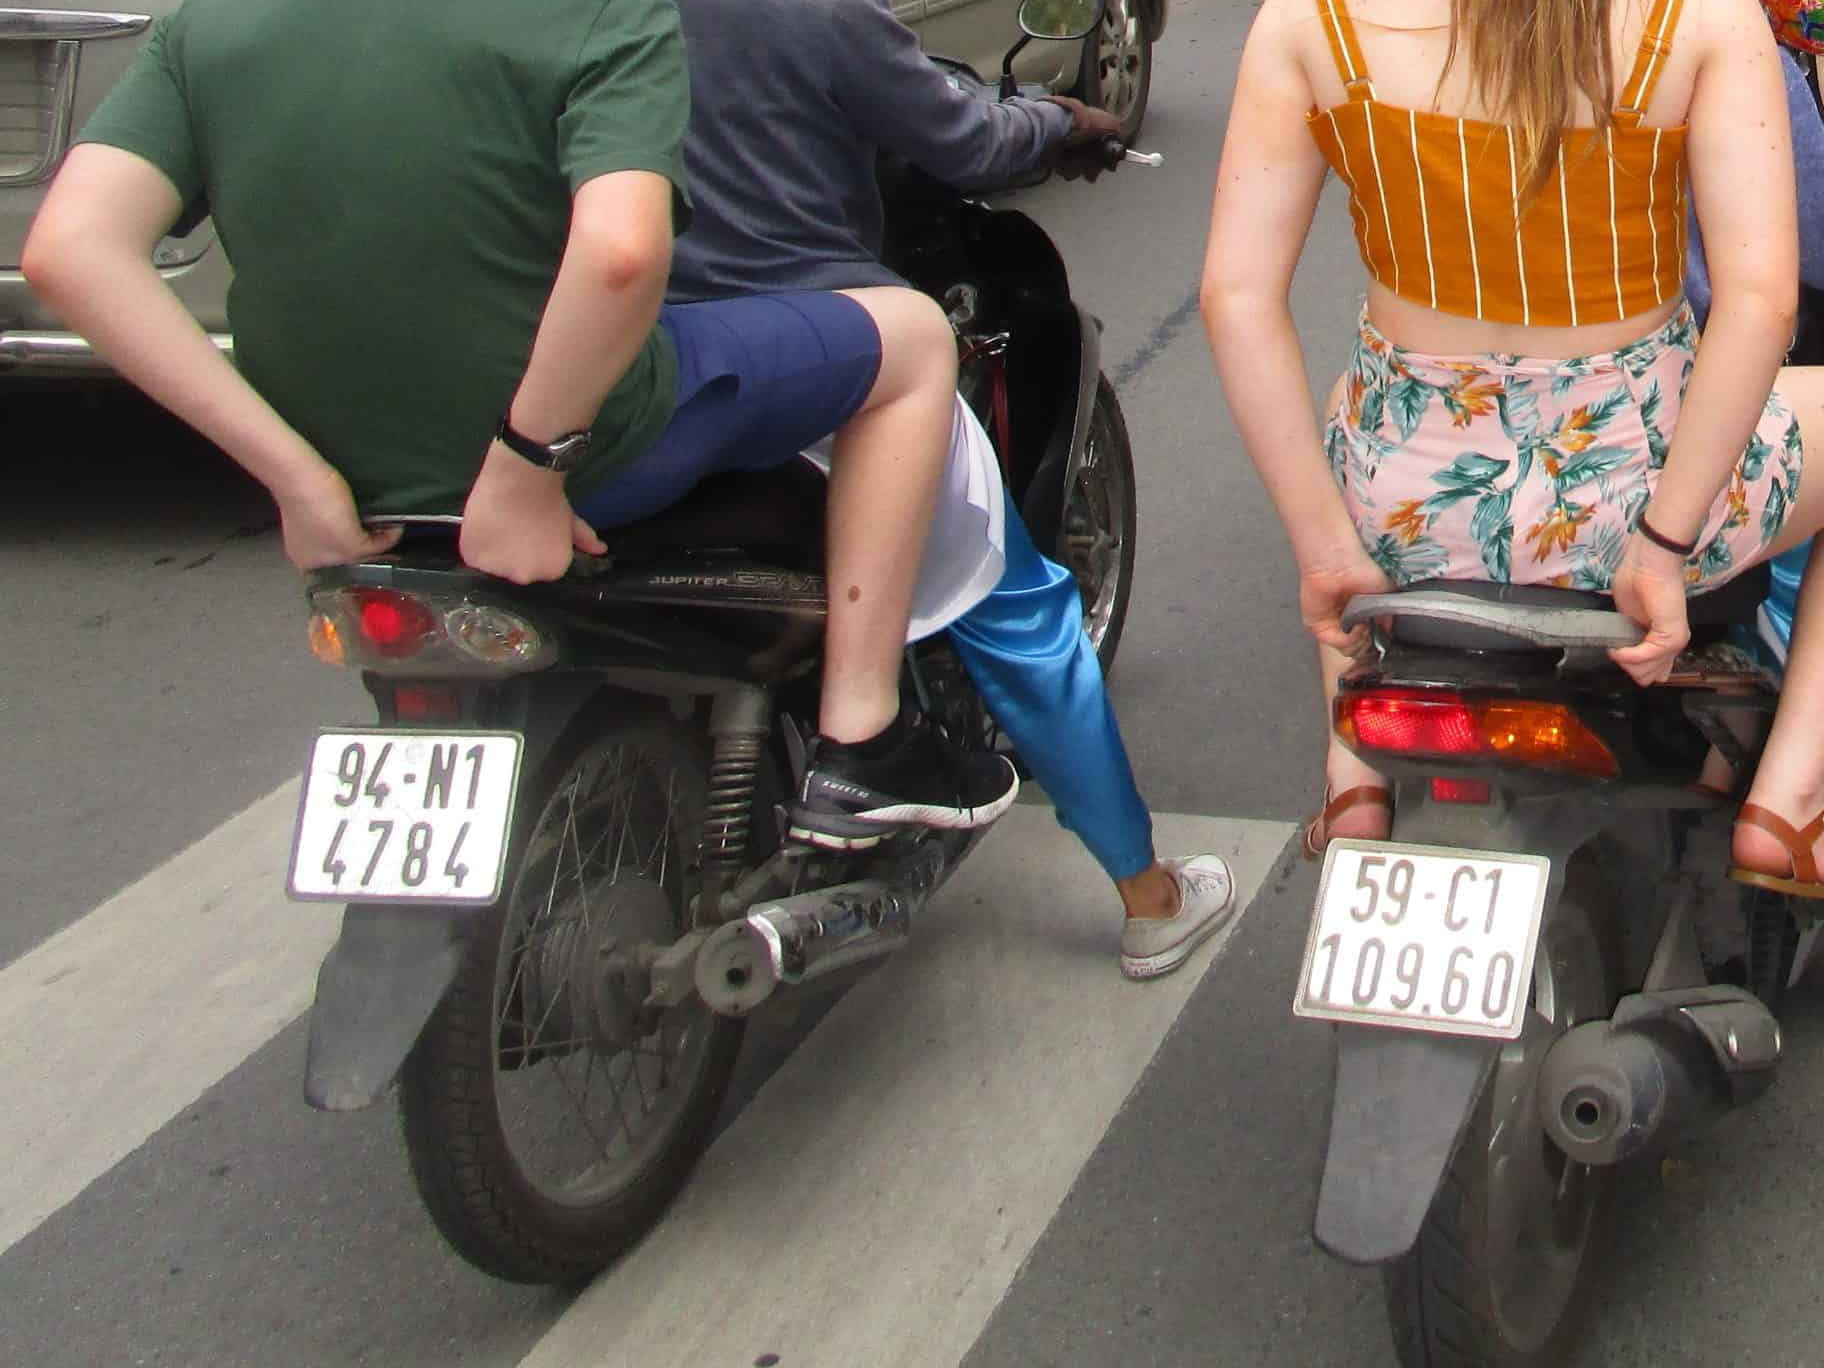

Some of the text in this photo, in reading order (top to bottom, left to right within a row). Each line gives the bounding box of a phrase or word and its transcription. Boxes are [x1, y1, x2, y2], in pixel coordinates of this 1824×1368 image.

[649, 575, 728, 586] JUPITER
[334, 742, 485, 810] 94-N1
[323, 819, 471, 888] 4784
[1350, 856, 1503, 935] 59-C1
[1319, 933, 1514, 1019] 109.60
